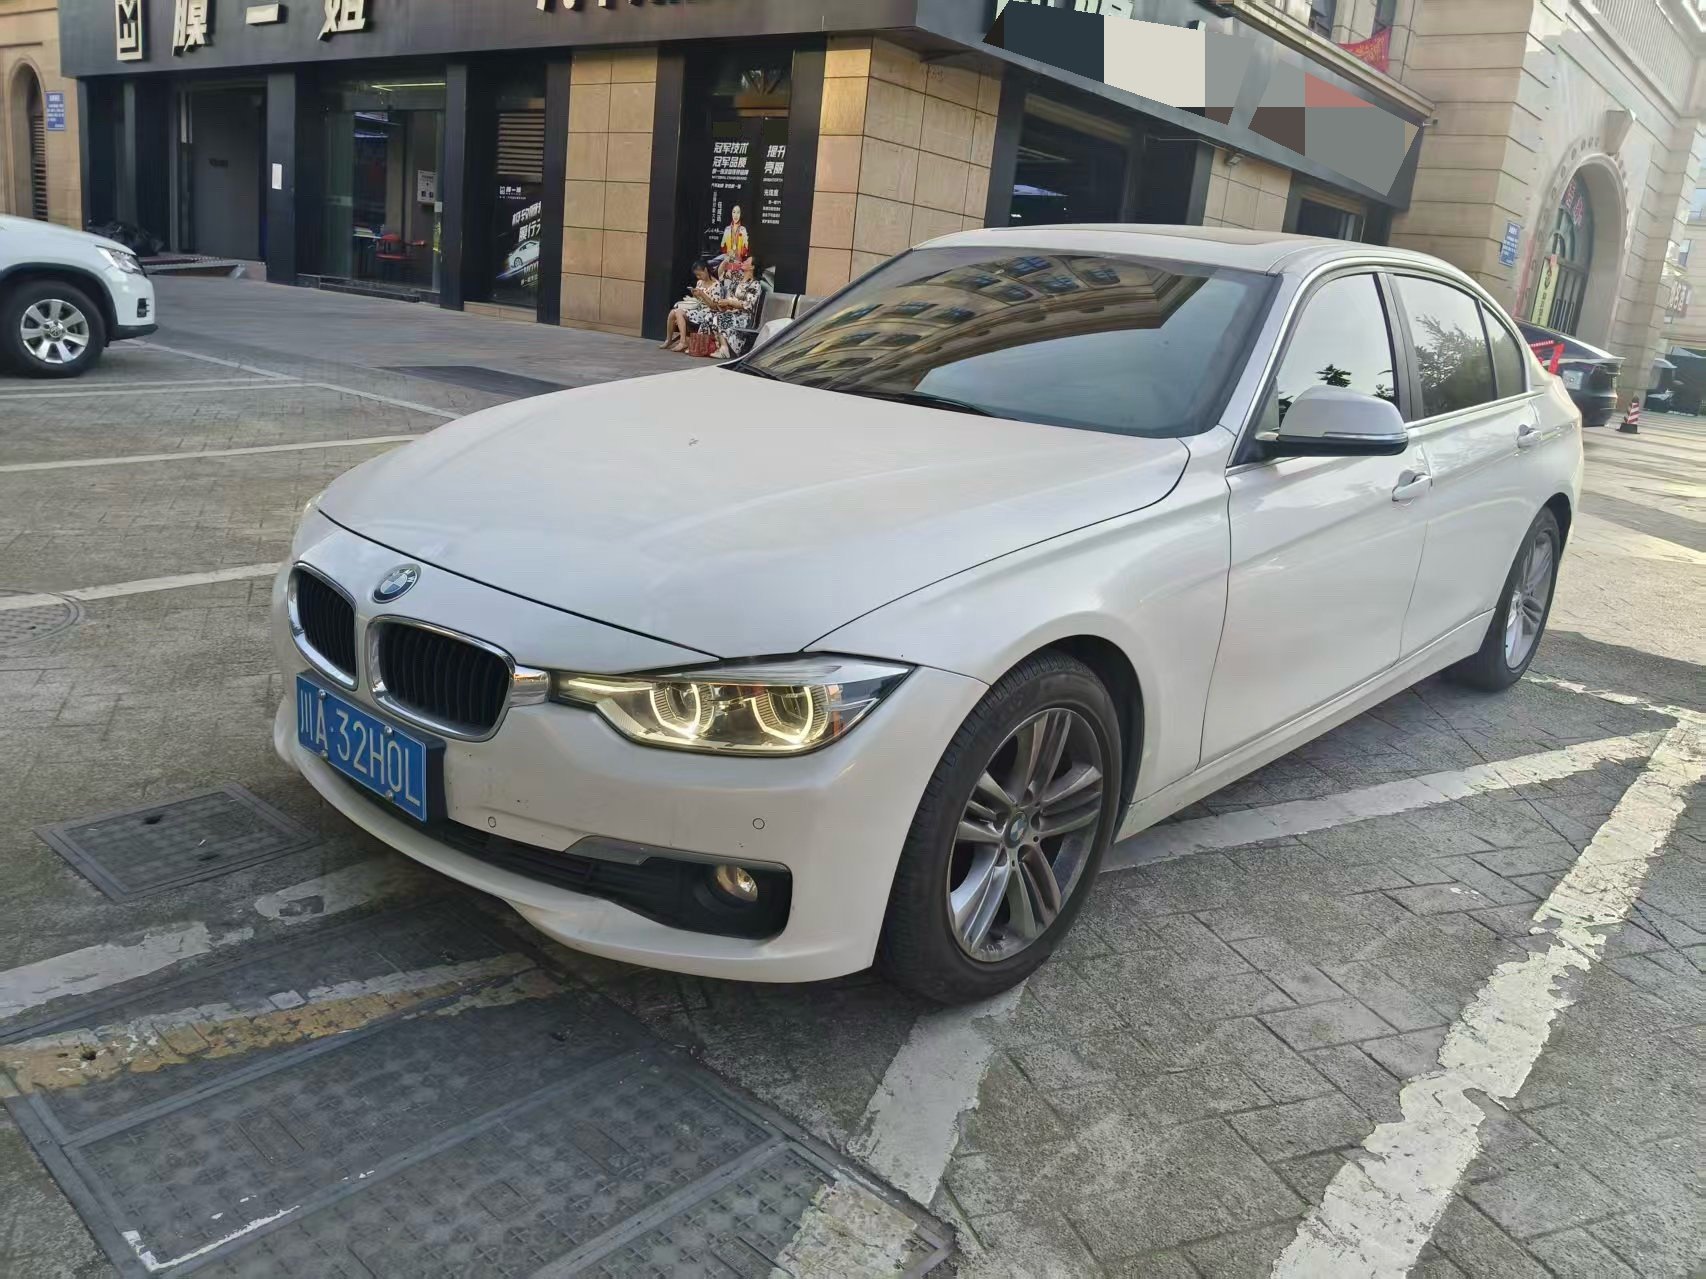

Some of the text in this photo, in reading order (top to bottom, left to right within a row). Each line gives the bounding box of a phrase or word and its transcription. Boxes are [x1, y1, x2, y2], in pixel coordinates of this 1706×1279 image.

[714, 142, 749, 154] 冠军技术
[767, 145, 786, 159] 提升
[765, 161, 785, 175] 亮丽
